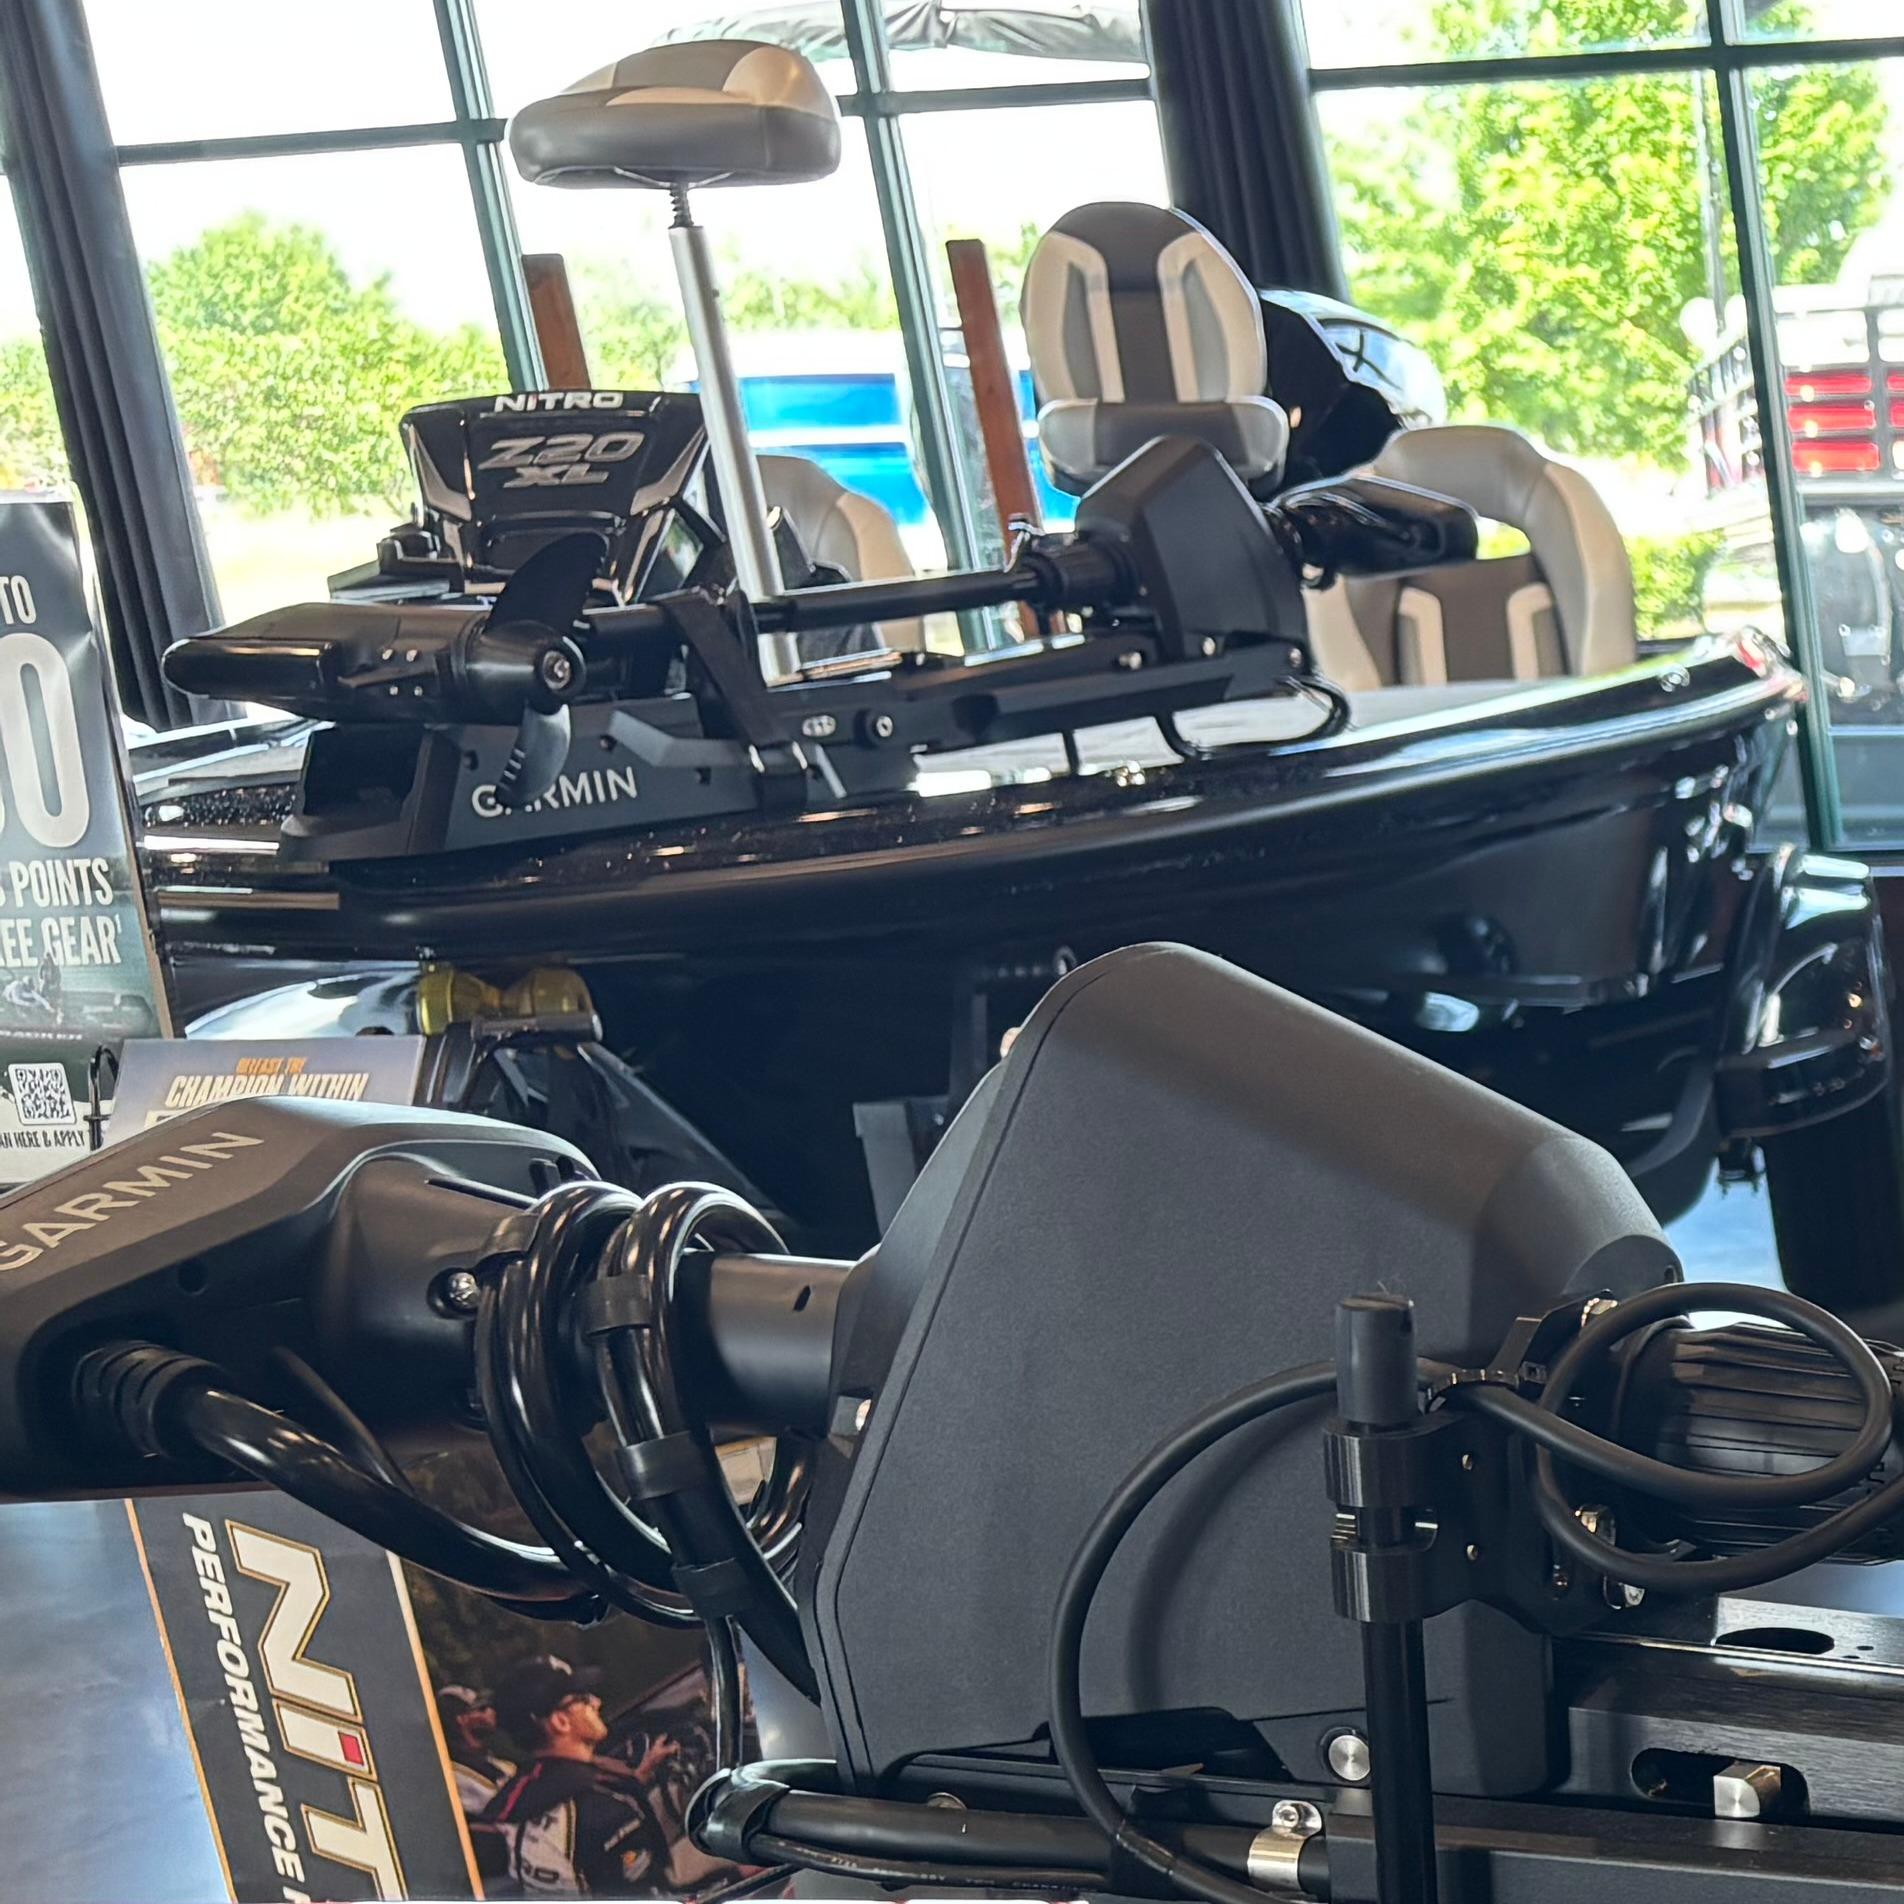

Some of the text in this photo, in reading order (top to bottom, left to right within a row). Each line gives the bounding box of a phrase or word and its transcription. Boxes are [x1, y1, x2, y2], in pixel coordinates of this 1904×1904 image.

[494, 391, 623, 412] NITRO
[478, 431, 645, 470] Z20
[503, 463, 609, 488] XL
[0, 575, 37, 625] TO
[8, 857, 113, 908] POINTS
[0, 917, 38, 968] EE
[165, 1072, 370, 1108] CHAMPION WITHIN
[15, 1129, 40, 1149] HERE
[54, 1129, 86, 1149] APPLY
[0, 1131, 264, 1272] GARMIN
[183, 1511, 306, 1885] PERFORMANCE
